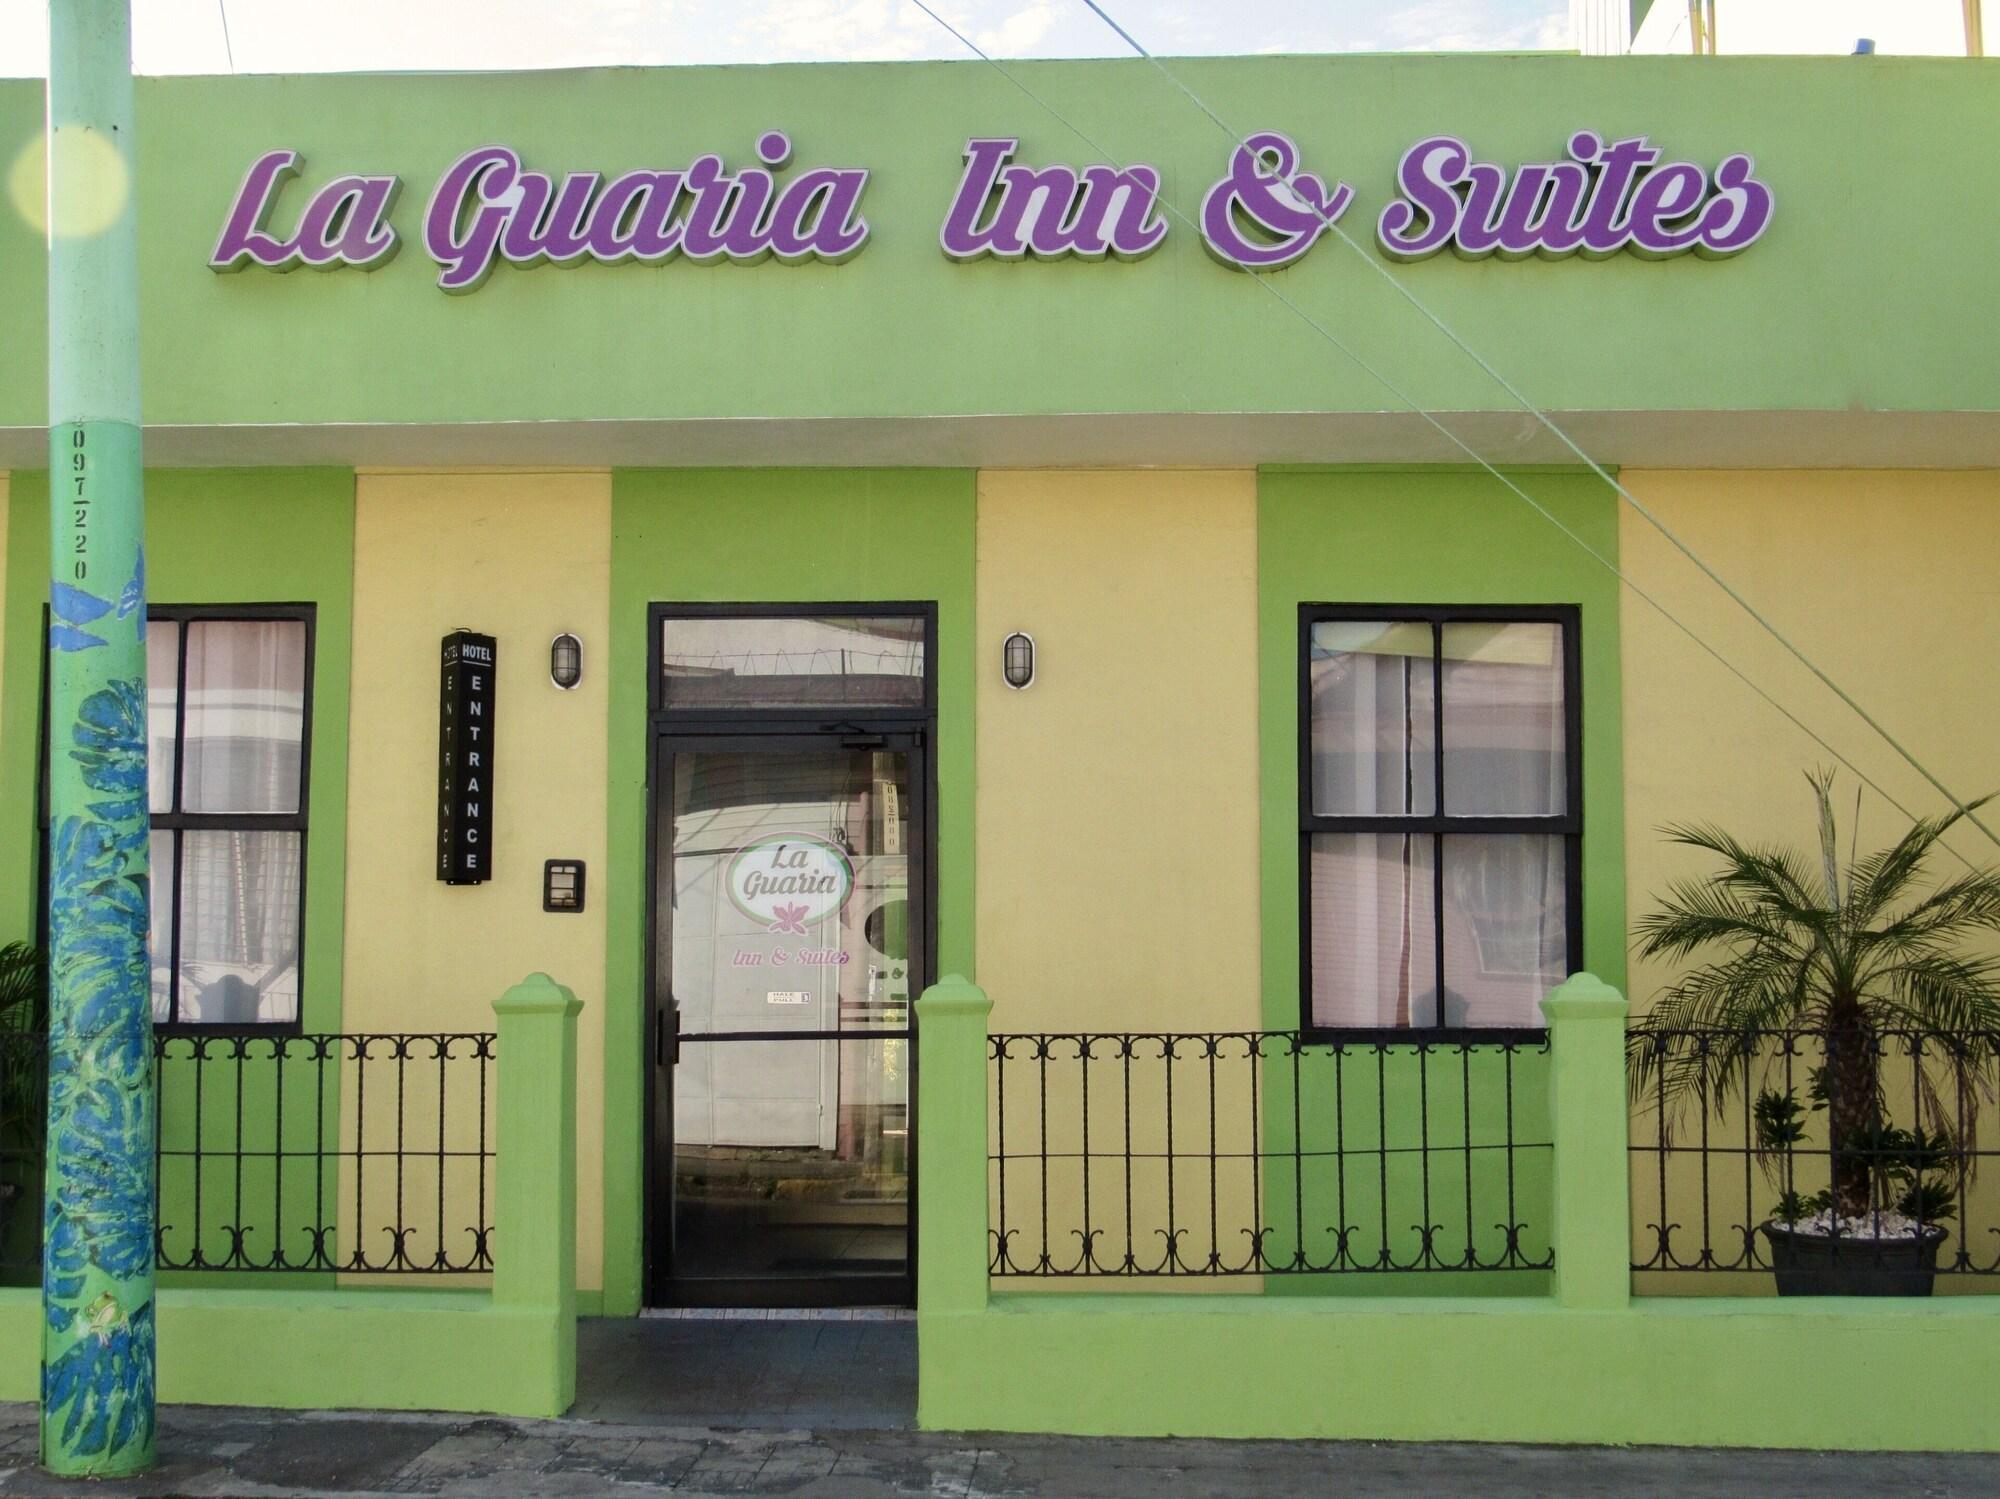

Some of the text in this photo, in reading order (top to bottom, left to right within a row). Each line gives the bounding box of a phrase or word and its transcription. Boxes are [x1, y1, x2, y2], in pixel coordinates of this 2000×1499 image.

[207, 128, 1776, 292] La Guaria Inn & Suites
[462, 643, 492, 661] HOTEL
[466, 675, 482, 869] ENTRANCE
[770, 844, 809, 869] La
[743, 868, 837, 900] Guaria
[732, 946, 850, 967] Inn & Suites
